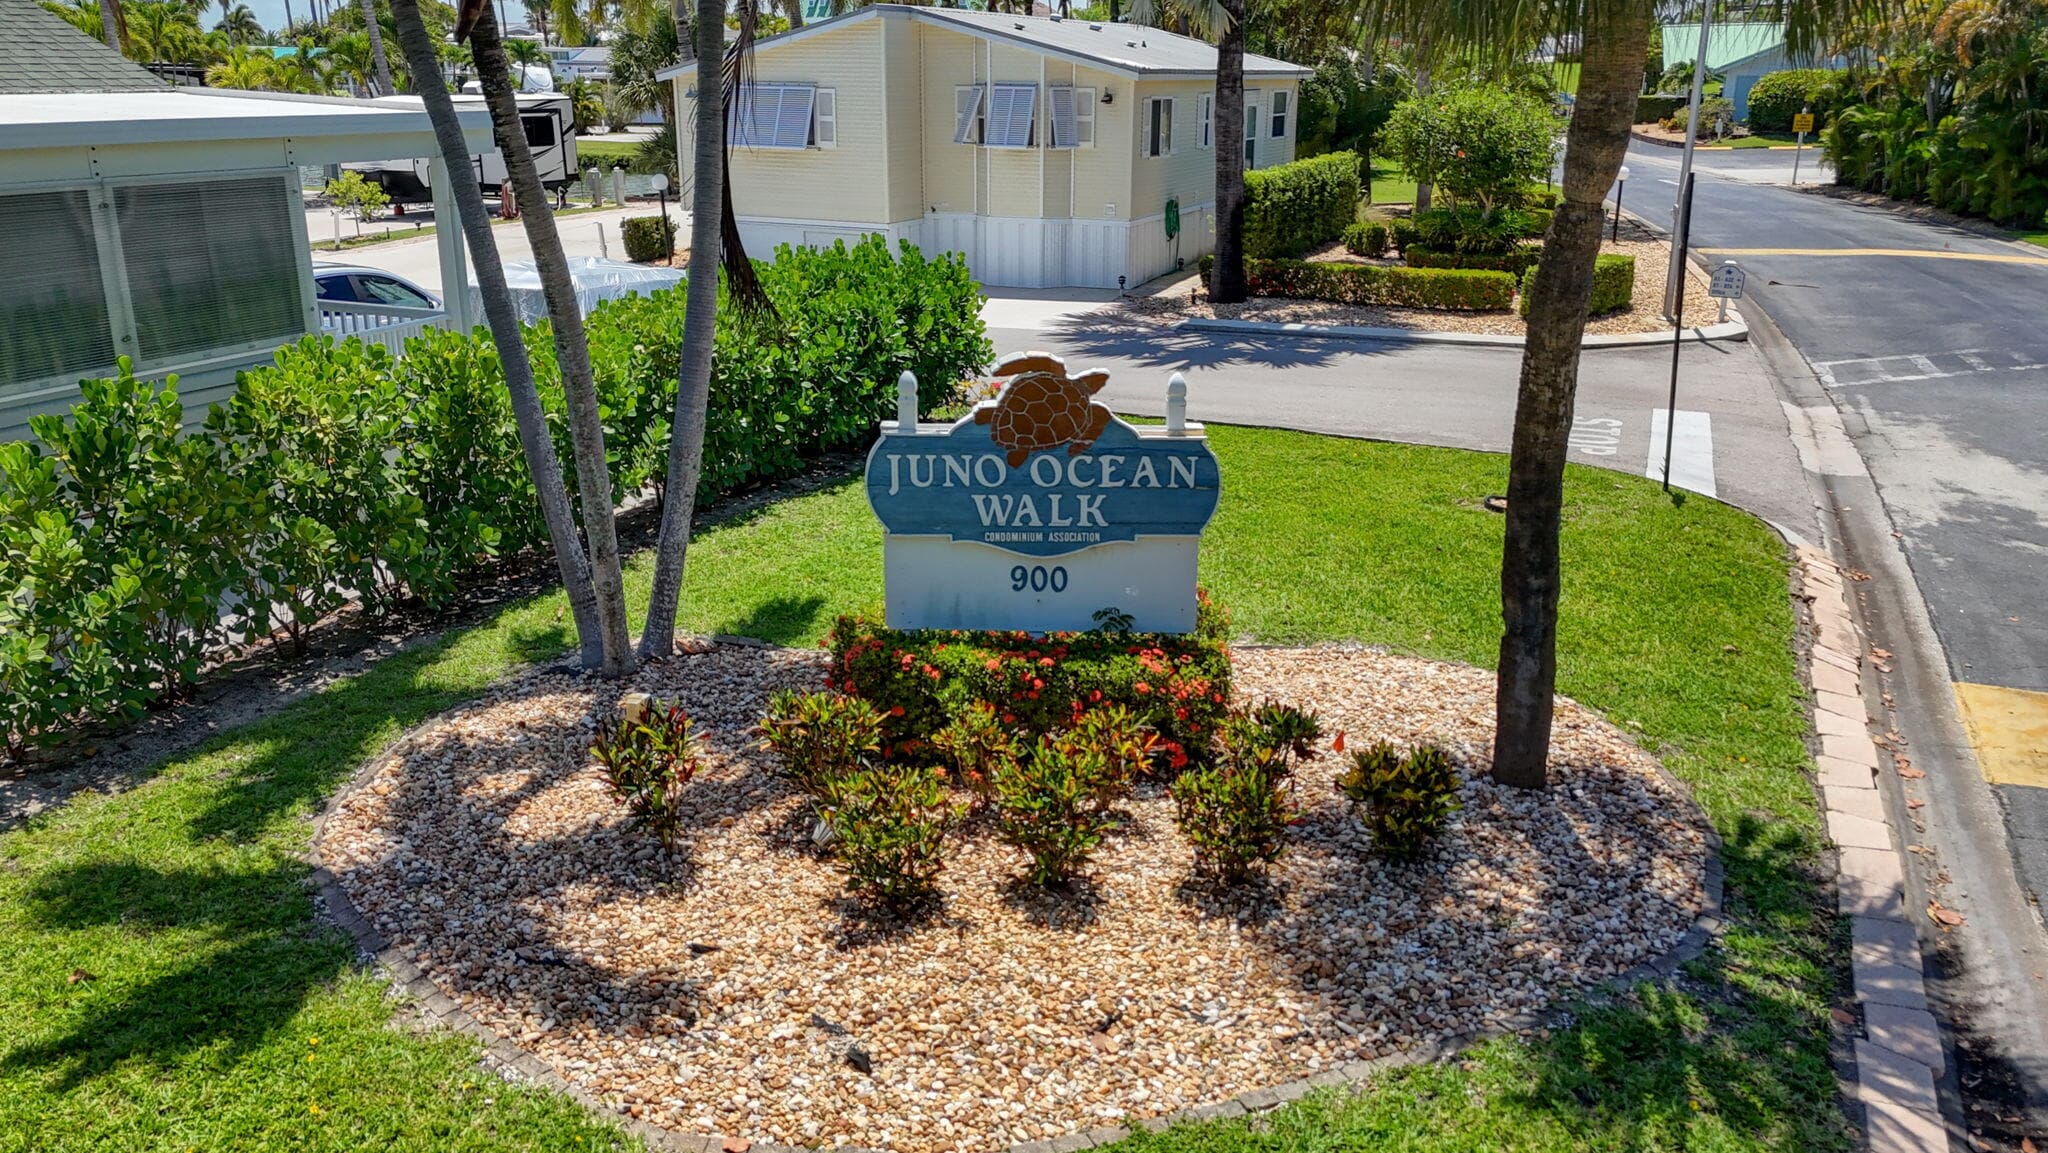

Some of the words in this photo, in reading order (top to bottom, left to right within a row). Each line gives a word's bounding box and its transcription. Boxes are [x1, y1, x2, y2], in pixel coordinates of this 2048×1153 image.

[886, 453, 1007, 496] JUNO
[1029, 454, 1199, 490] OCEAN
[971, 493, 1109, 528] WALK
[984, 532, 1043, 542] CONDOMINIUM
[1048, 532, 1100, 542] ASSOCIATION
[1010, 565, 1068, 593] 900
